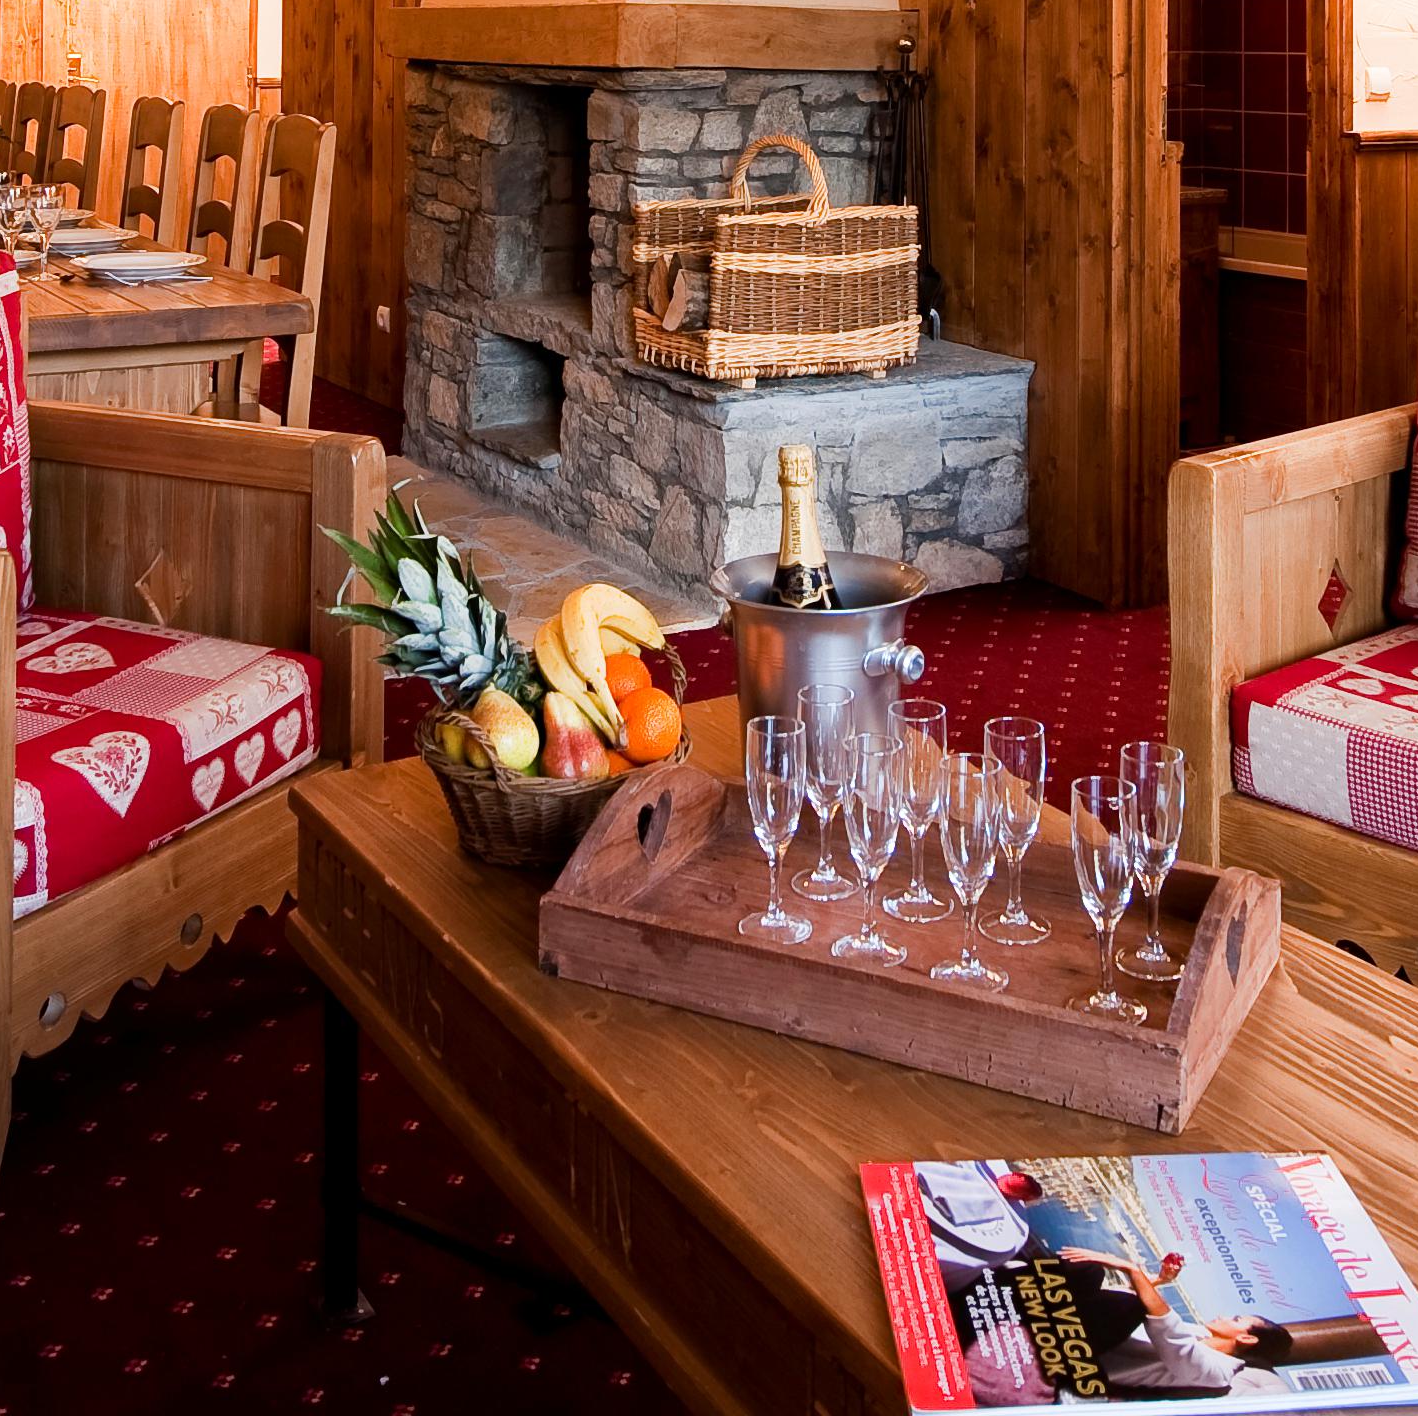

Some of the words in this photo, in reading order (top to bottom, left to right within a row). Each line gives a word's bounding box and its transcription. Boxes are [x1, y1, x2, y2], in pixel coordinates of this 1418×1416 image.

[789, 499, 802, 555] CHAMPAGNE
[1244, 1185, 1290, 1242] SPÉCIAL
[1277, 1156, 1346, 1242] Voyage
[1330, 1248, 1372, 1279] de
[981, 1268, 996, 1283] des
[1193, 1198, 1256, 1304] exceptionnelles
[986, 1284, 1003, 1306] stars
[1015, 1275, 1047, 1318] NEW
[1033, 1258, 1074, 1303] LAS
[999, 1286, 1023, 1325] Nouvelle
[974, 1329, 992, 1357] mode
[1030, 1322, 1066, 1375] LOOK
[1049, 1305, 1106, 1394] VEGAS
